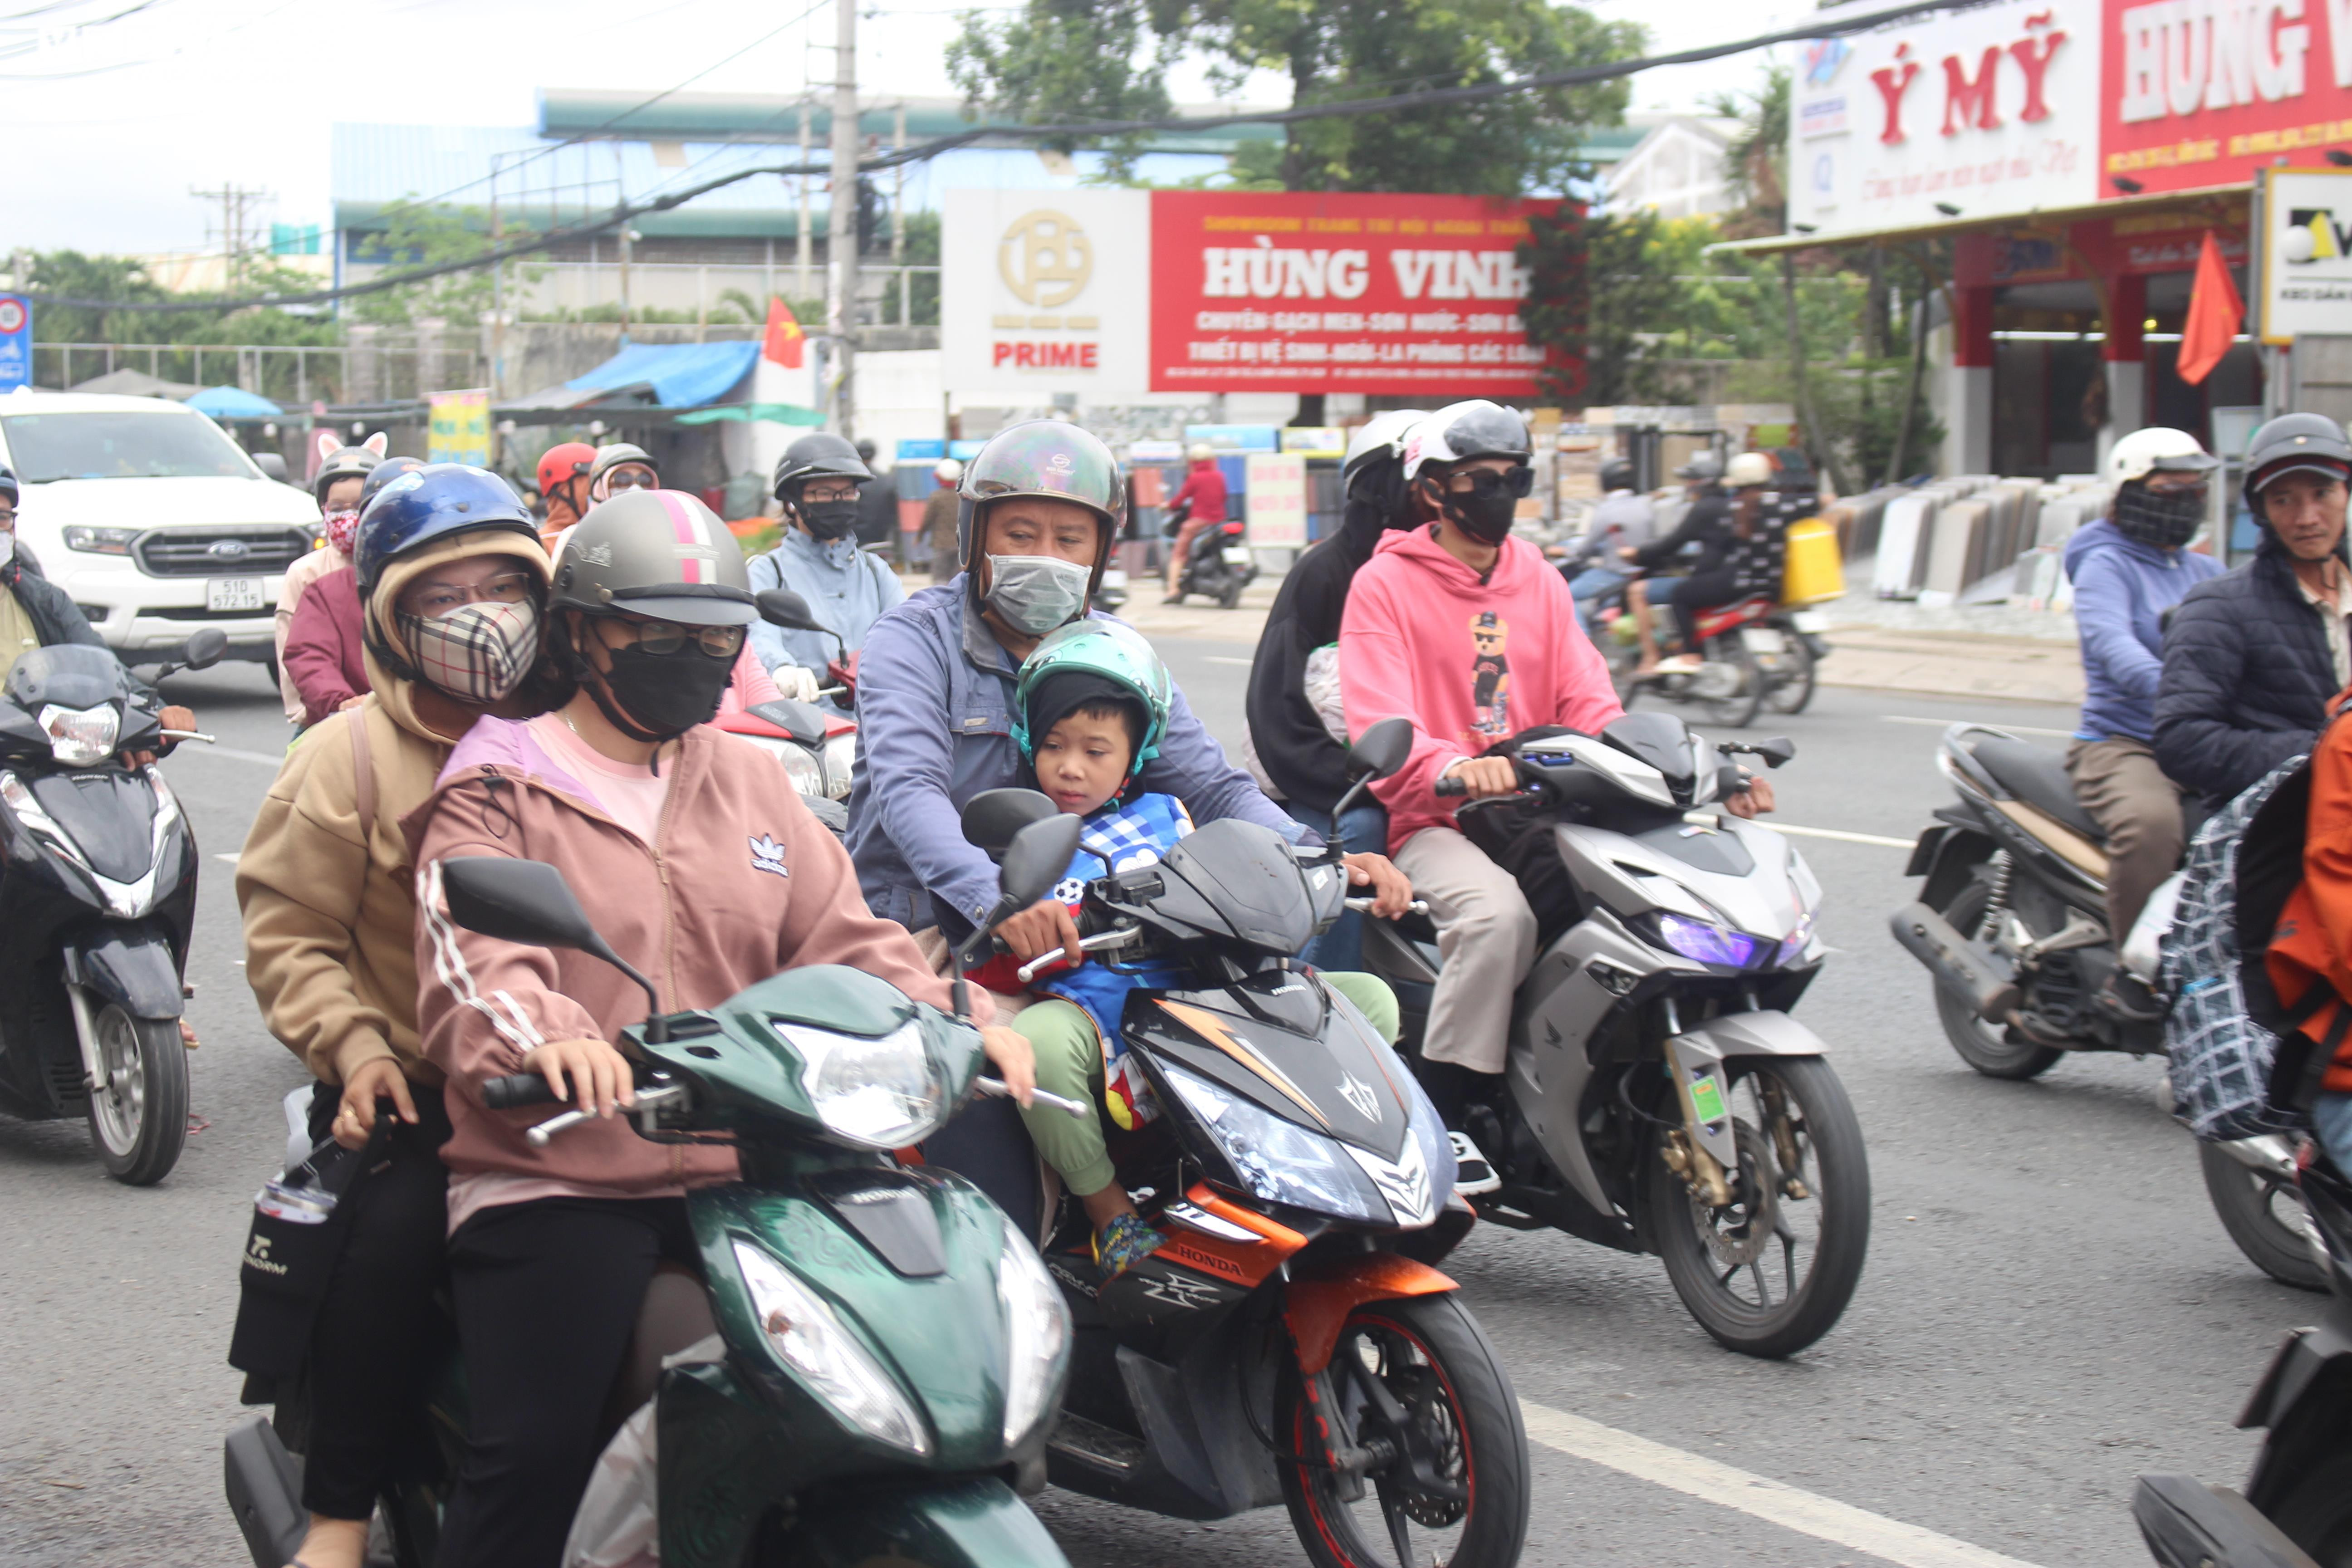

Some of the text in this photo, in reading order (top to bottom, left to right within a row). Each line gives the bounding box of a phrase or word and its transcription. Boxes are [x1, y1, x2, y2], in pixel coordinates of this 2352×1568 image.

[1869, 7, 2067, 145] Ý MỸ
[1203, 235, 1535, 300] HÙNG VINH
[992, 341, 1100, 368] PRIME
[223, 580, 248, 593] 51D
[1180, 1245, 1243, 1277] HONDA
